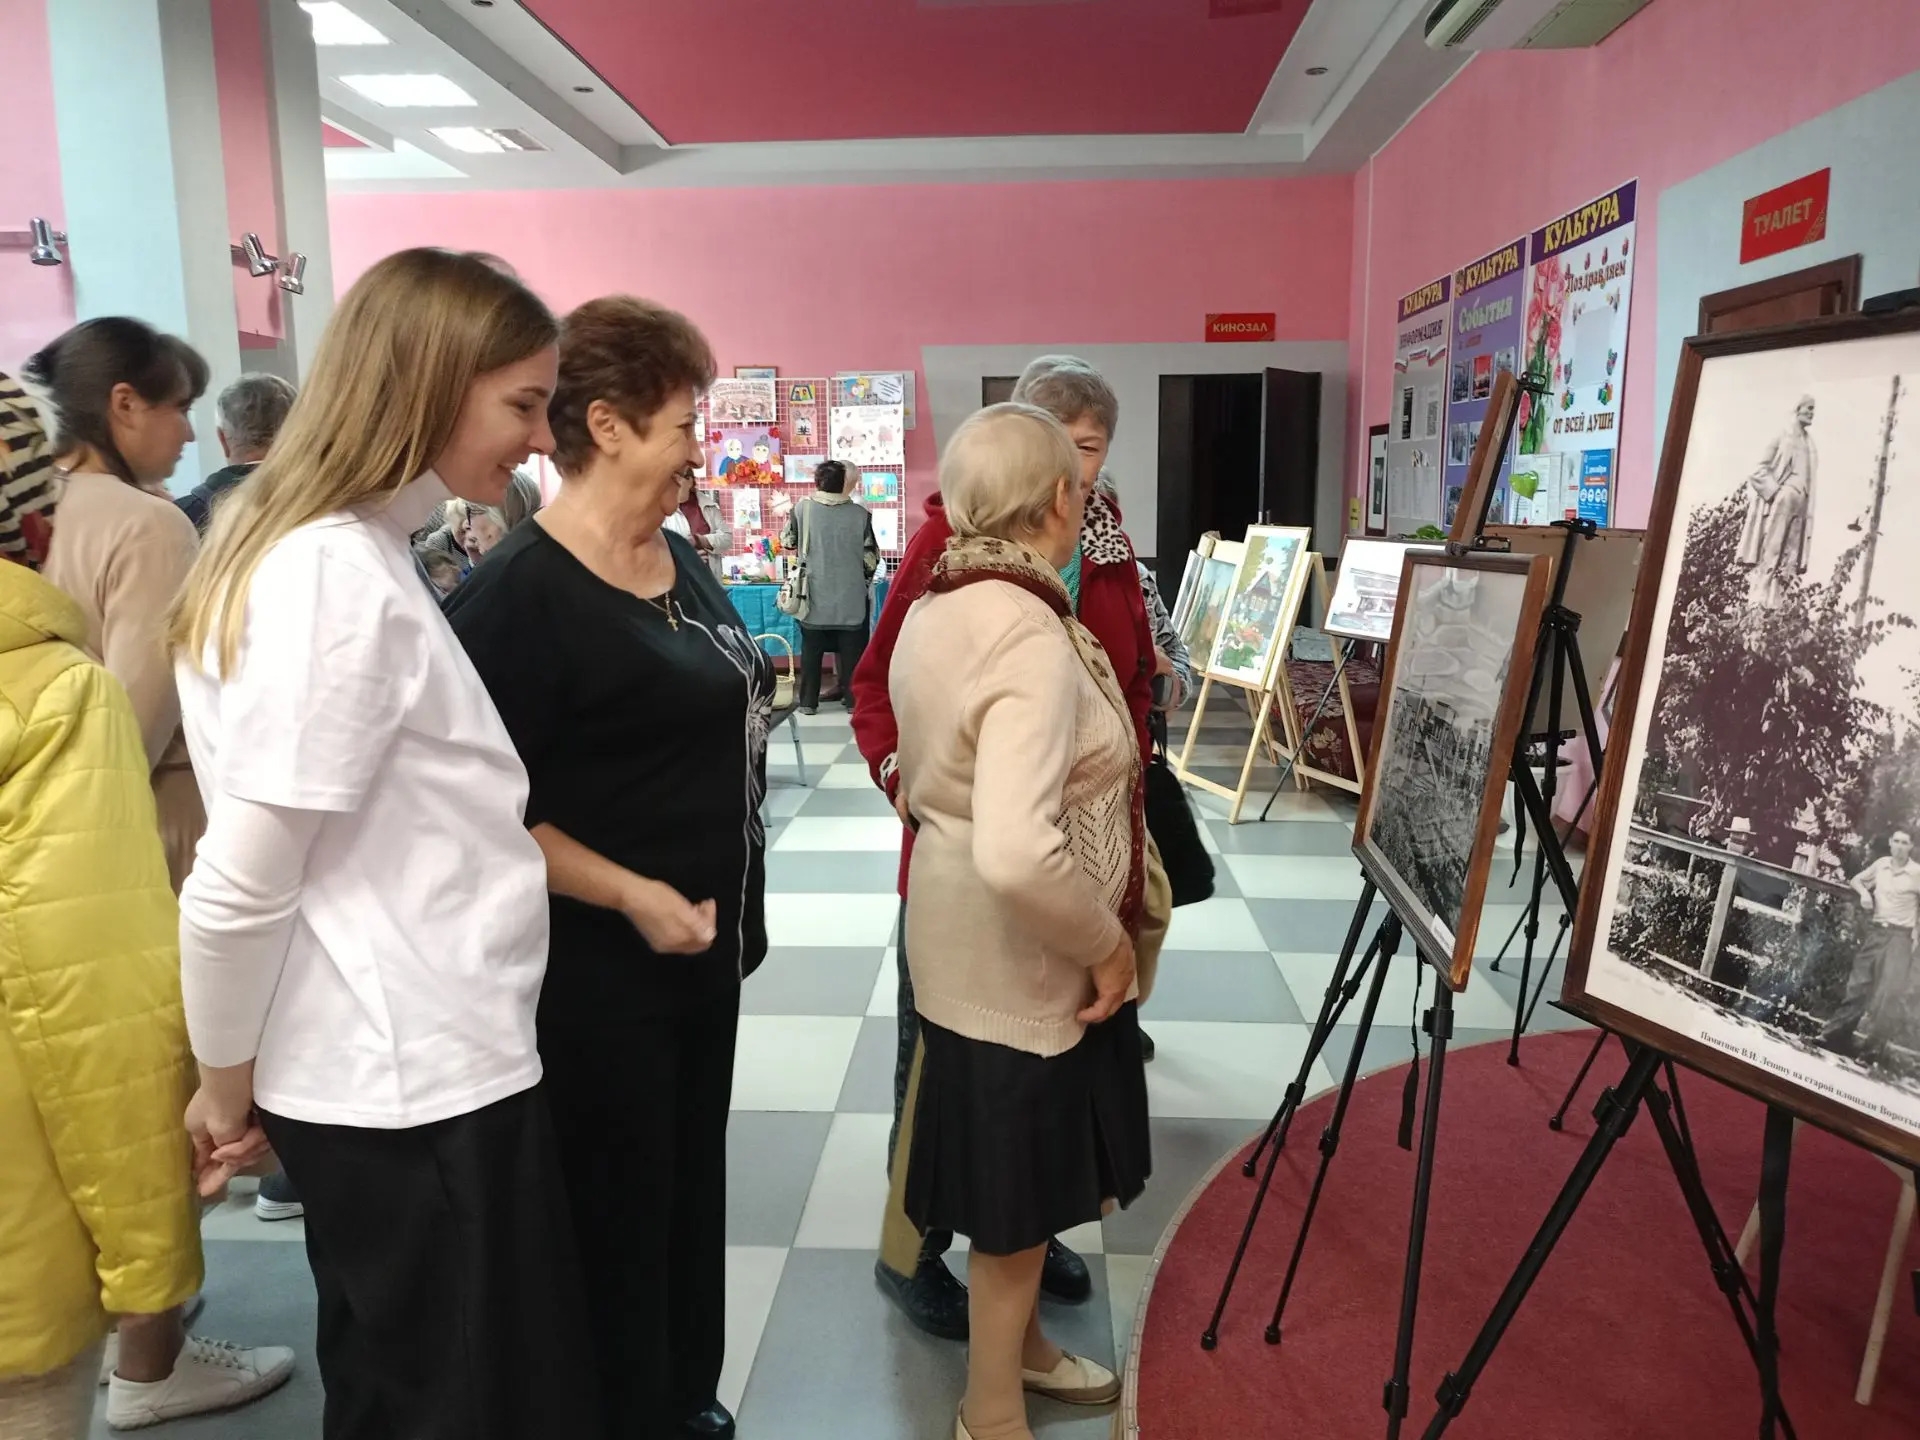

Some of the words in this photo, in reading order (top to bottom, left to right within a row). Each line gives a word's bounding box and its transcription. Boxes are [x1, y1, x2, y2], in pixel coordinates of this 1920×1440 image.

[1543, 192, 1620, 253] КУЛЬТУРА
[1754, 198, 1813, 237] ТУАЛЕТ
[1465, 245, 1518, 291] КУЛЬТУРА
[1403, 280, 1443, 316] КУЛЬТУРА
[1459, 296, 1513, 334] События
[1213, 322, 1268, 333] КИНОЗАЛ
[1553, 418, 1563, 434] ОТ
[1564, 412, 1585, 433] ВСЕЙ
[1586, 412, 1615, 432] ДУШИ
[1700, 1031, 1740, 1055] Памятник
[1741, 1047, 1758, 1062] В.И.
[1760, 1056, 1791, 1076] Ленину
[1792, 1071, 1803, 1081] на
[1804, 1075, 1834, 1094] старой
[1836, 1089, 1878, 1112] площади
[1879, 1104, 1920, 1129] Вороты
